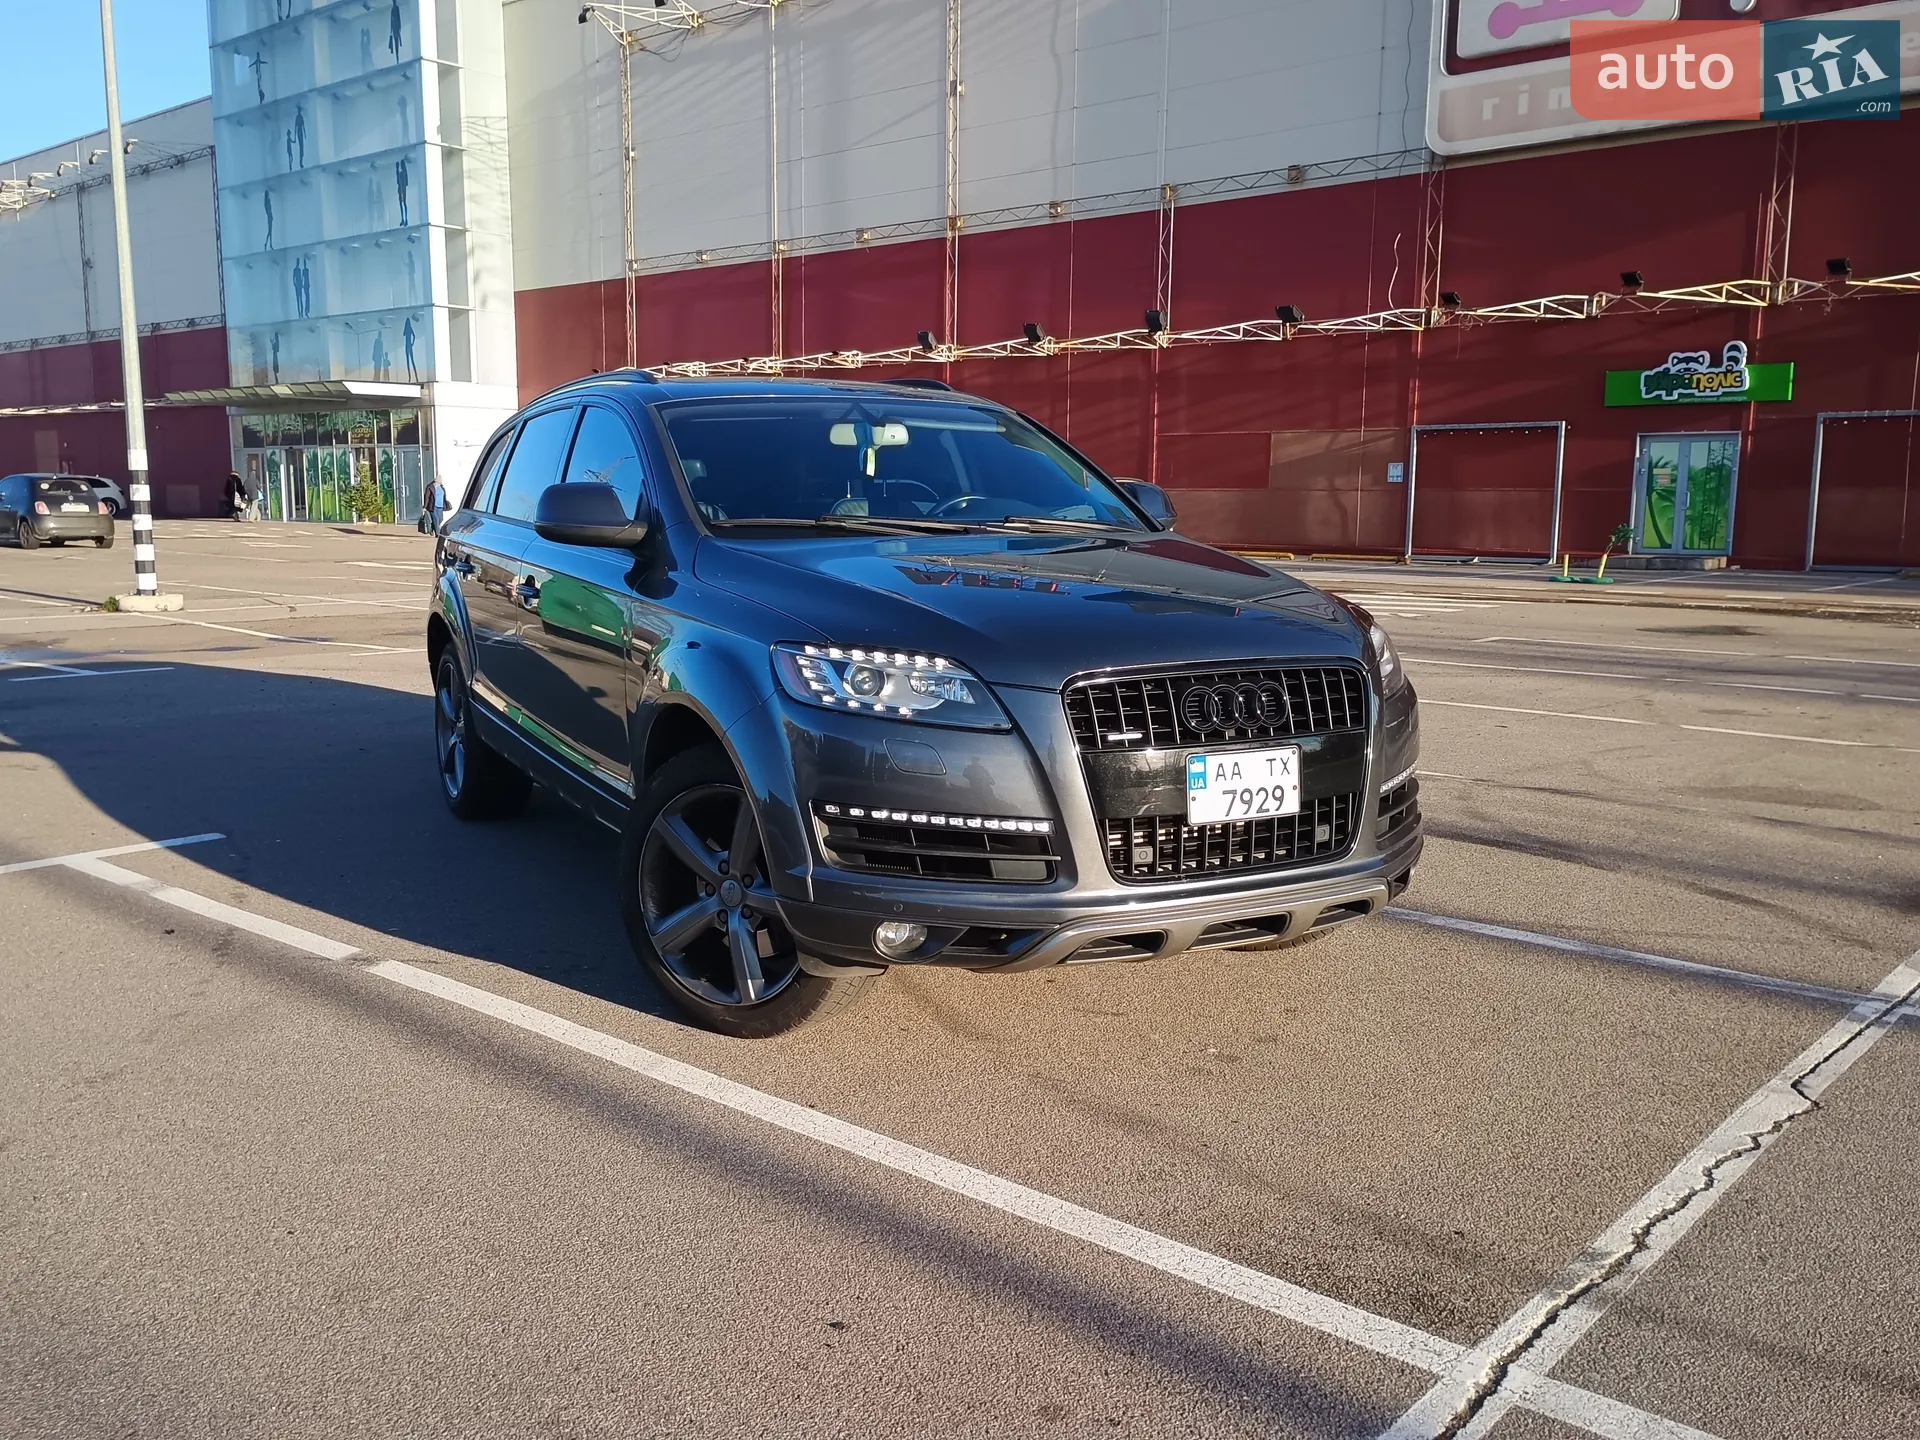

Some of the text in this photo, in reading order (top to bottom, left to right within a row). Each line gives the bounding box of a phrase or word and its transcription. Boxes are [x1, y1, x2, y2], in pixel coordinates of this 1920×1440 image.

[1215, 756, 1291, 782] AA TX
[1191, 777, 1206, 789] UA
[1222, 784, 1285, 818] 7929
